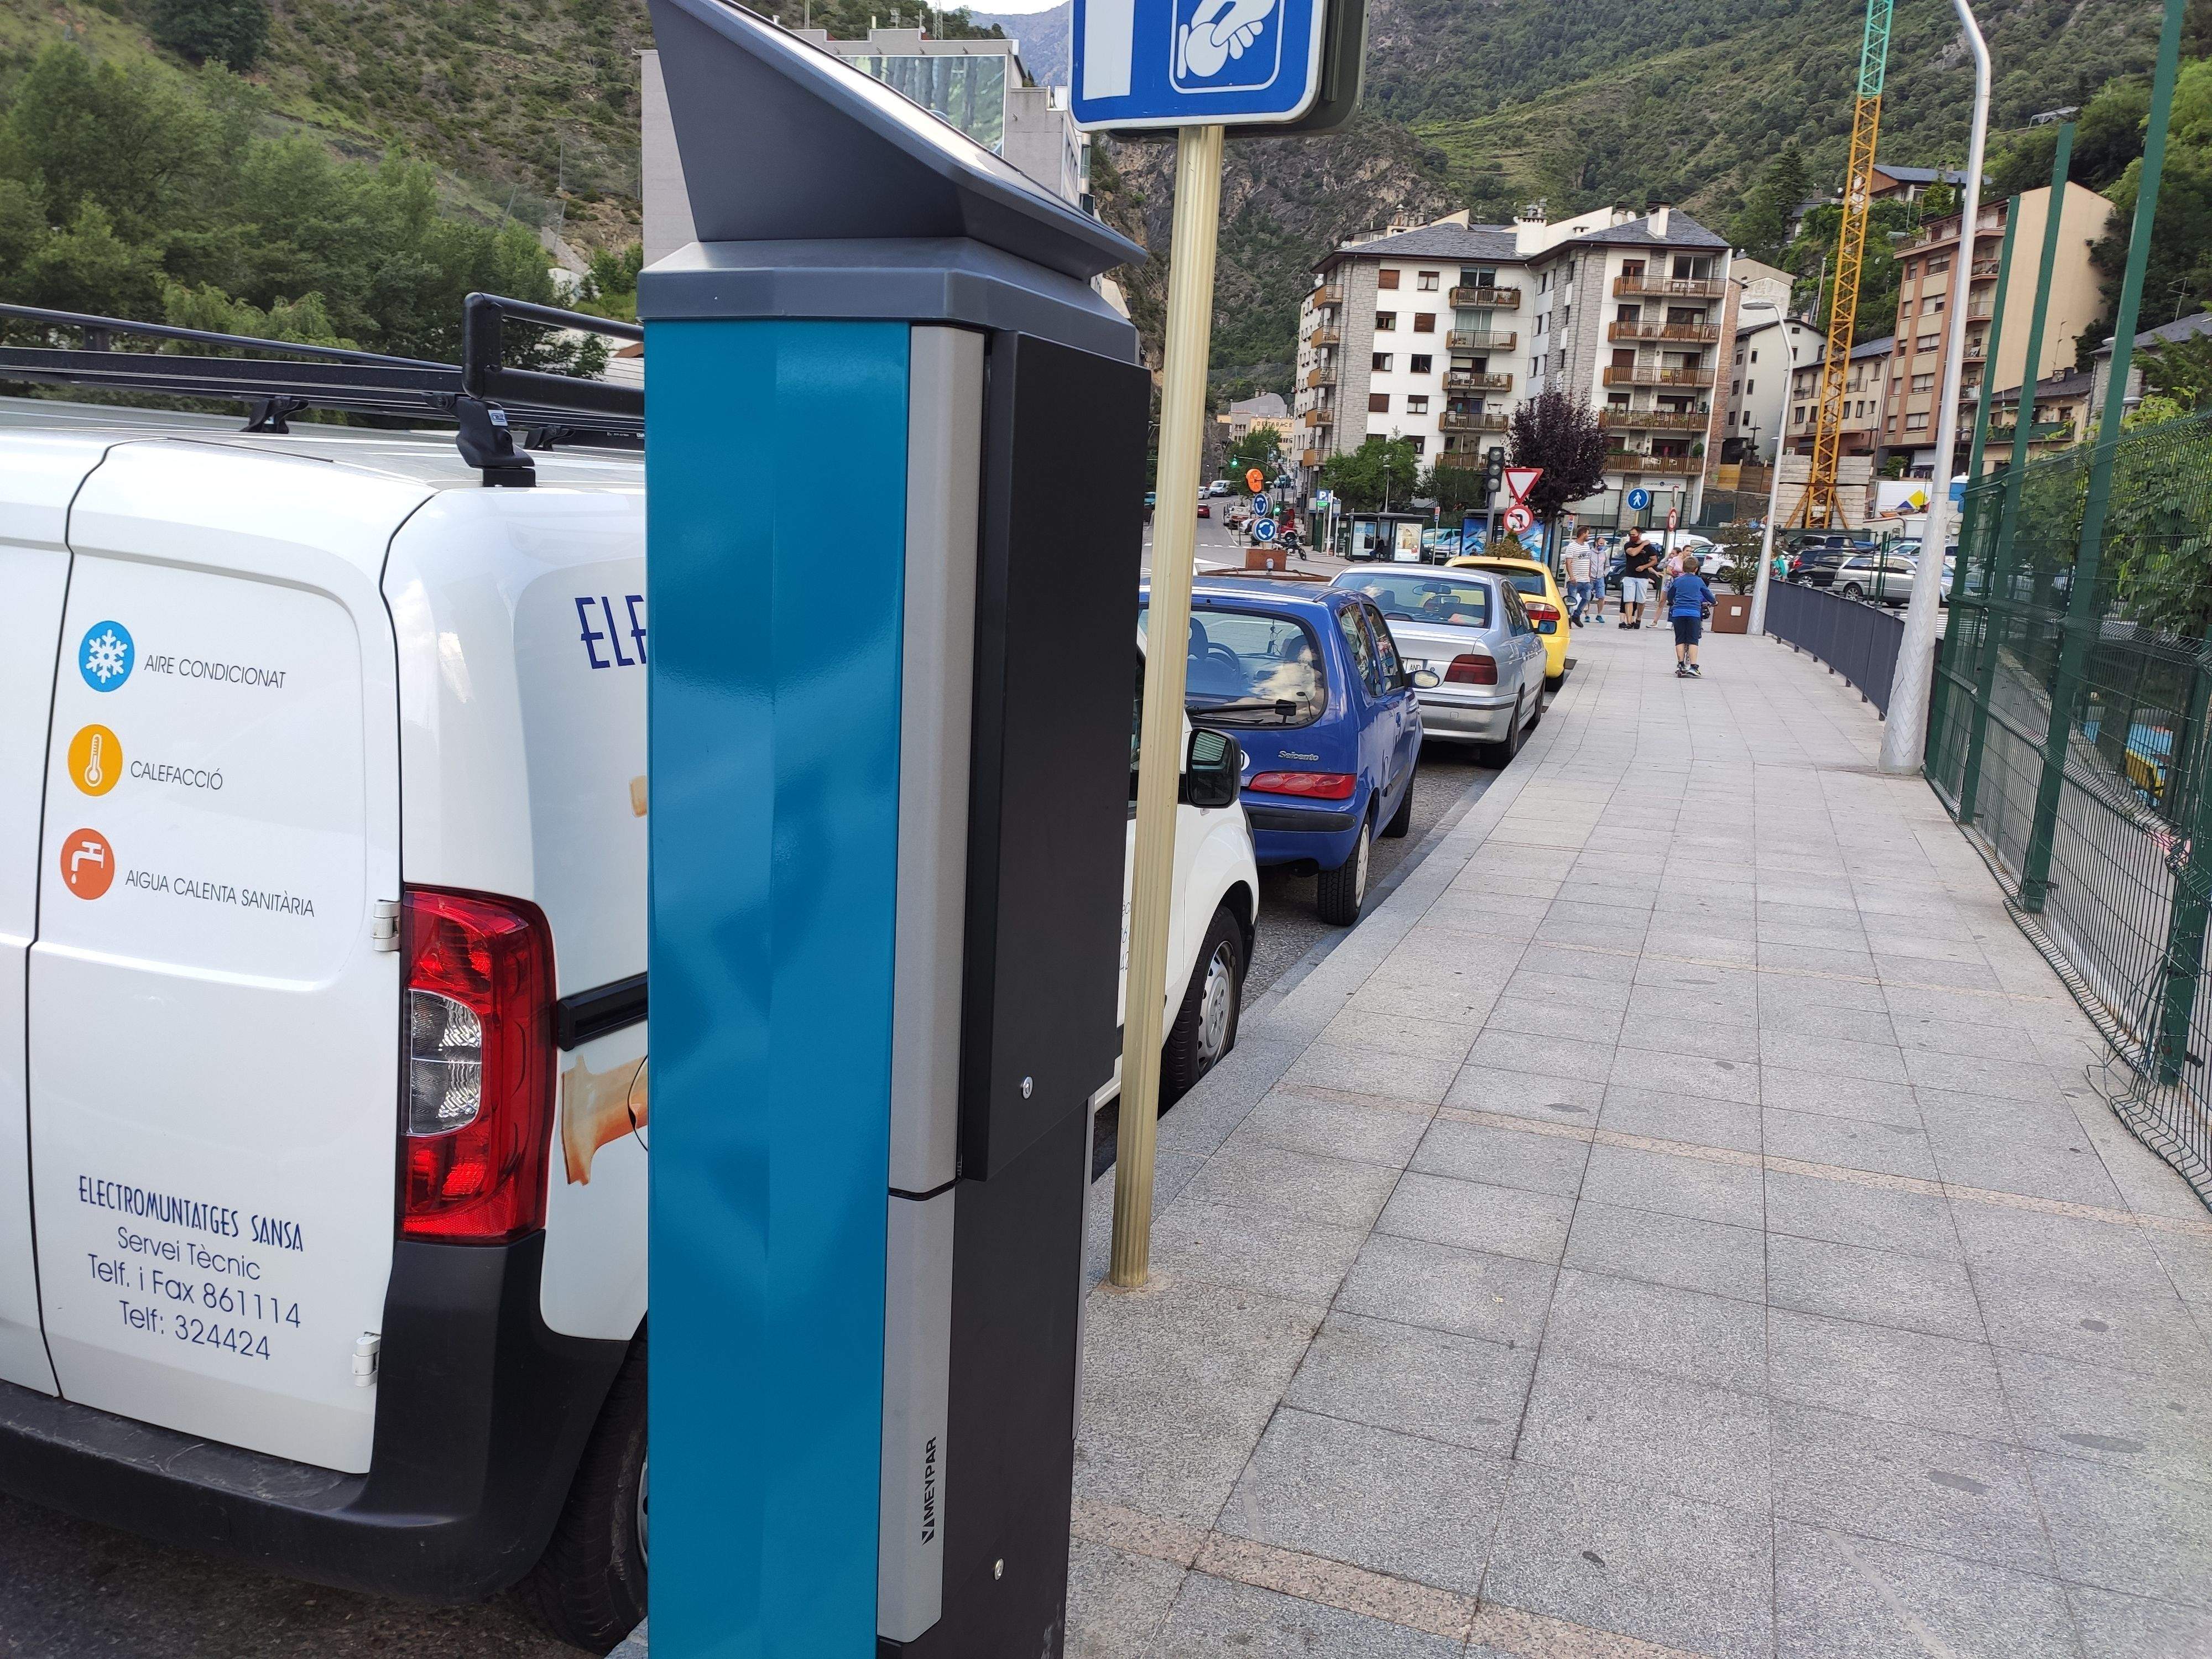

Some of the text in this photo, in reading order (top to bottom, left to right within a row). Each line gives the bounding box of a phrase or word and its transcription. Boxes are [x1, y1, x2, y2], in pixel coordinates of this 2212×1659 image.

[1319, 491, 1327, 499] P
[144, 654, 286, 689] AIRE CONDICIONAT
[131, 760, 223, 790] CALEFACCIÓ
[1277, 750, 1319, 761] Seicento
[125, 869, 315, 917] AIGUA CALENTA SANITÀRIA
[79, 1175, 304, 1252] ELECTROMUNTATGES SANSA
[117, 1226, 260, 1280] Servei Tècnic
[87, 1253, 301, 1328] Telf. i Fax 861114
[119, 1300, 271, 1361] Telf: 324424
[924, 1436, 937, 1522] MEYPAR
